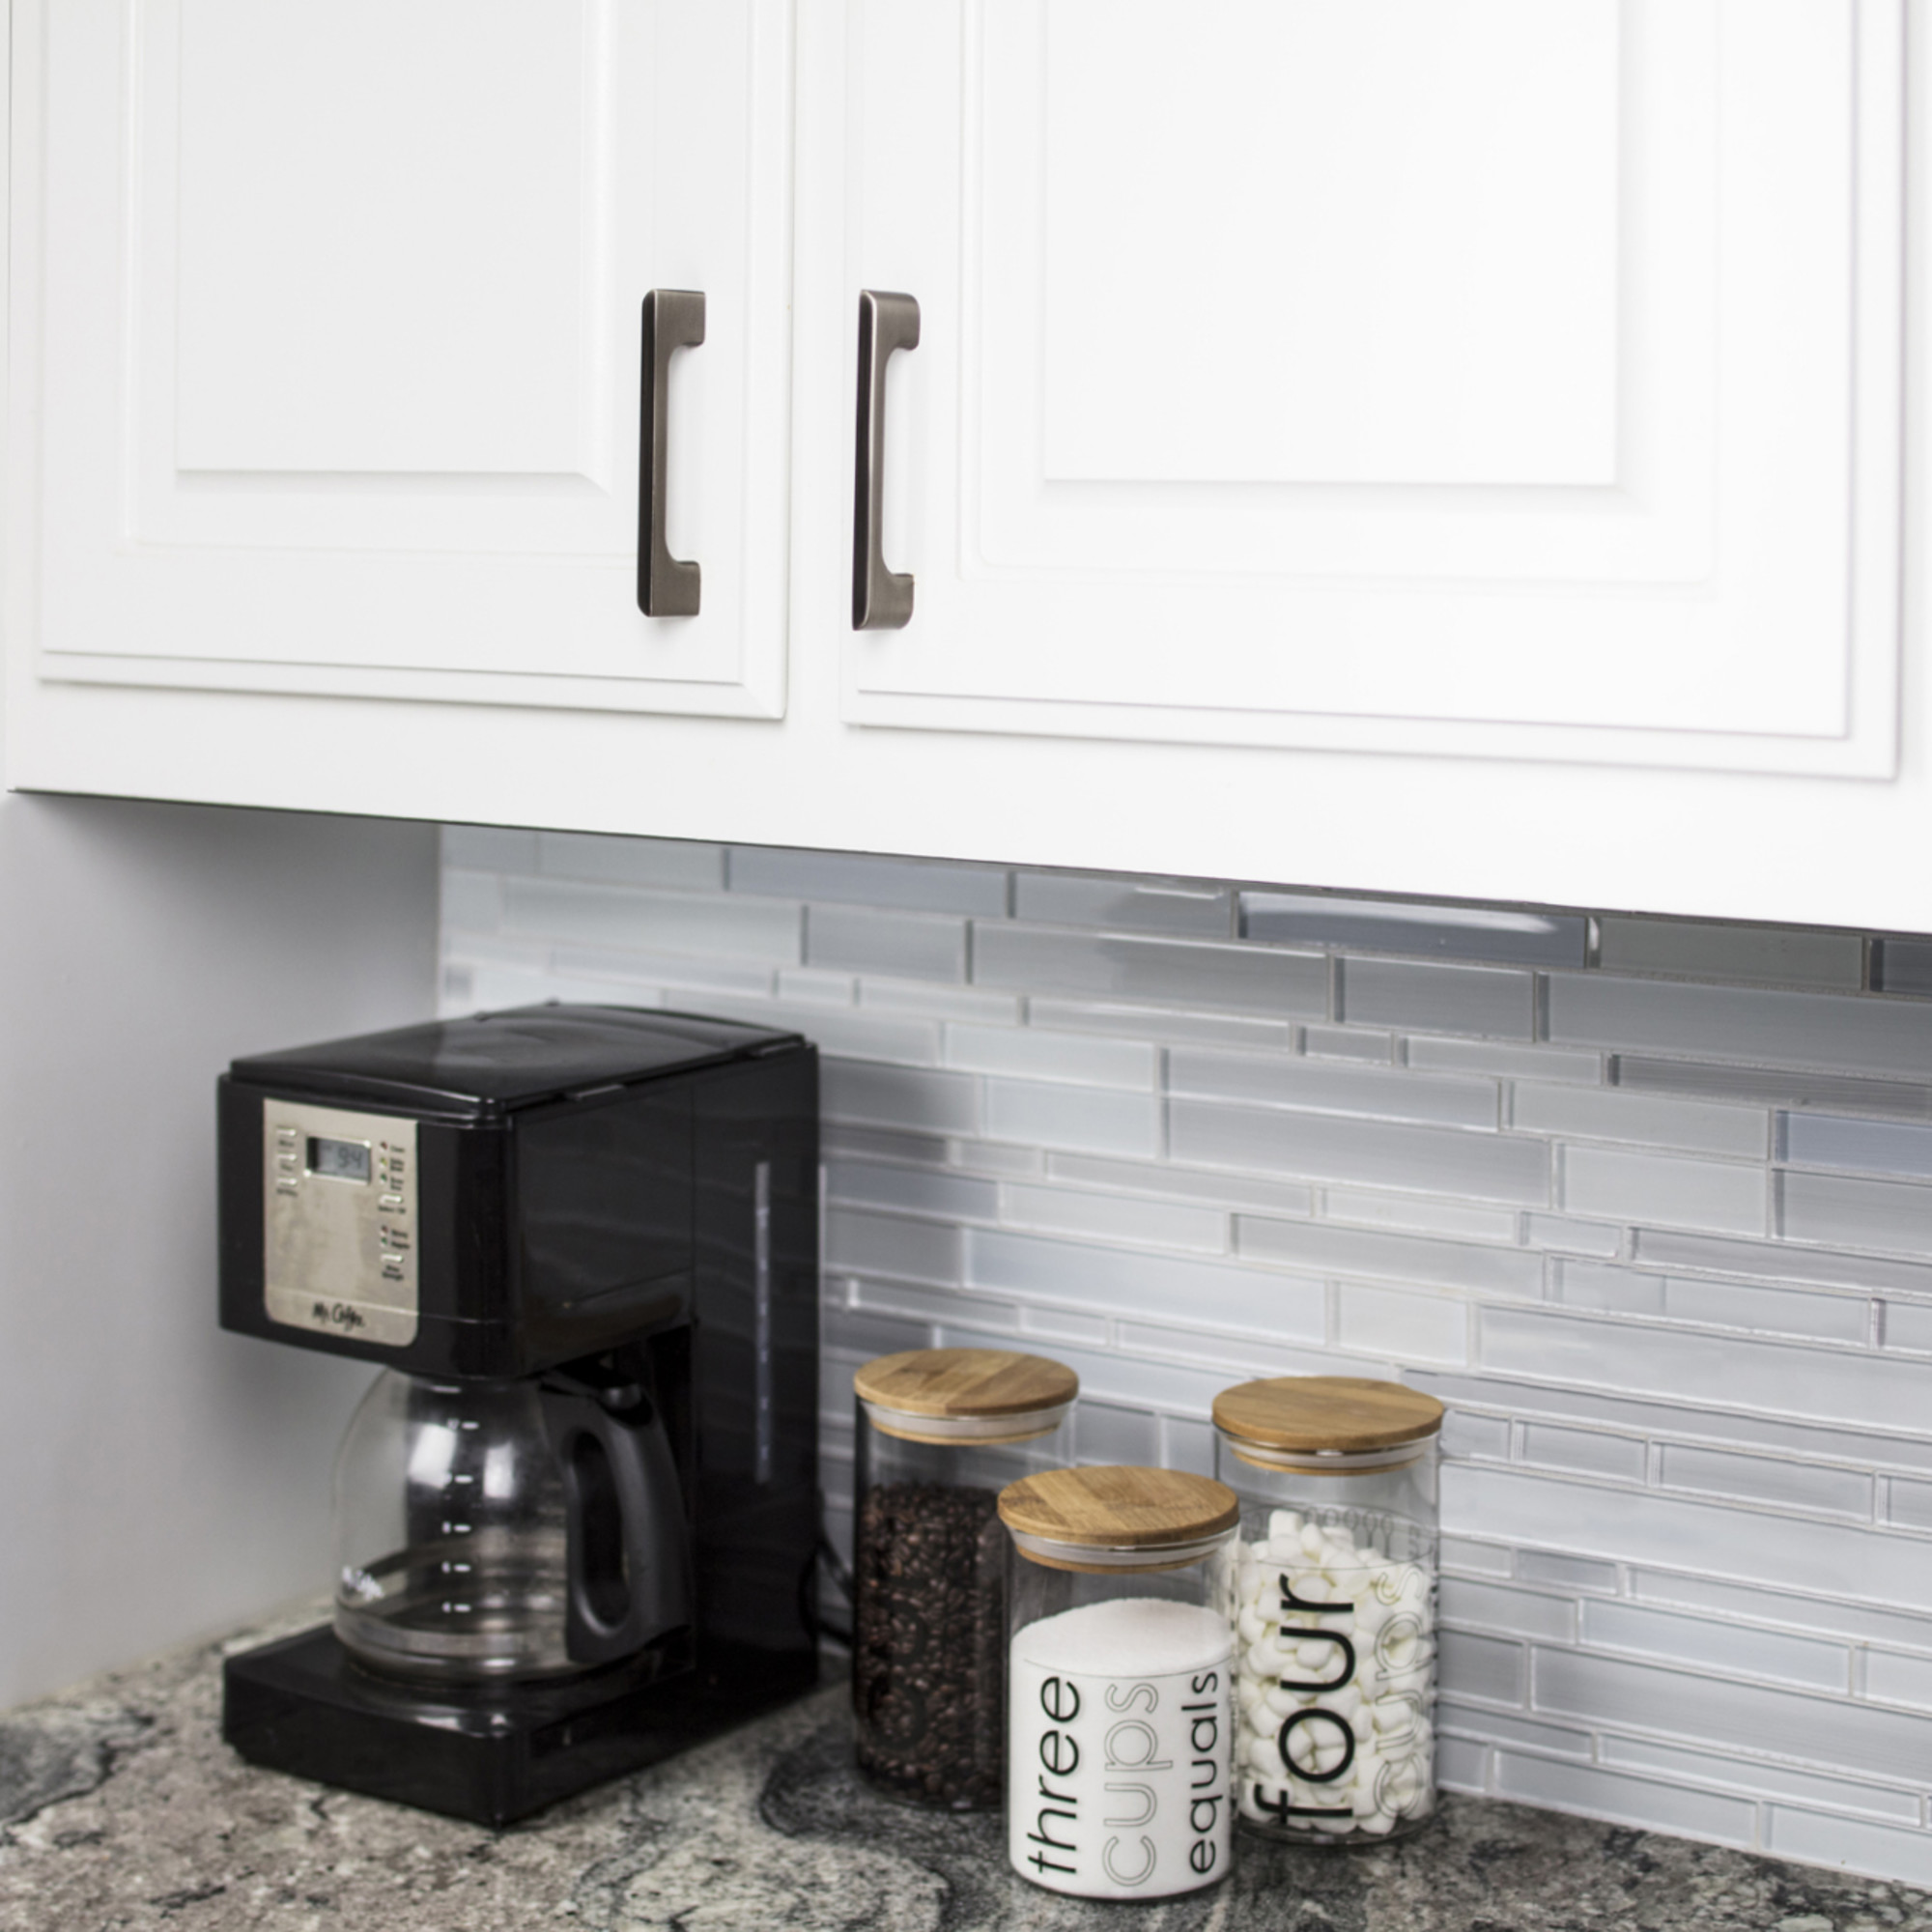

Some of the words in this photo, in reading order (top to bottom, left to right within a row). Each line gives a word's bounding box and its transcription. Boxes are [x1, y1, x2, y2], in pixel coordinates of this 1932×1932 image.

[1026, 1676, 1081, 1875] three
[1102, 1682, 1174, 1888] cups
[1180, 1671, 1224, 1875] equals
[1254, 1574, 1356, 1825] four
[1373, 1563, 1437, 1819] cups
